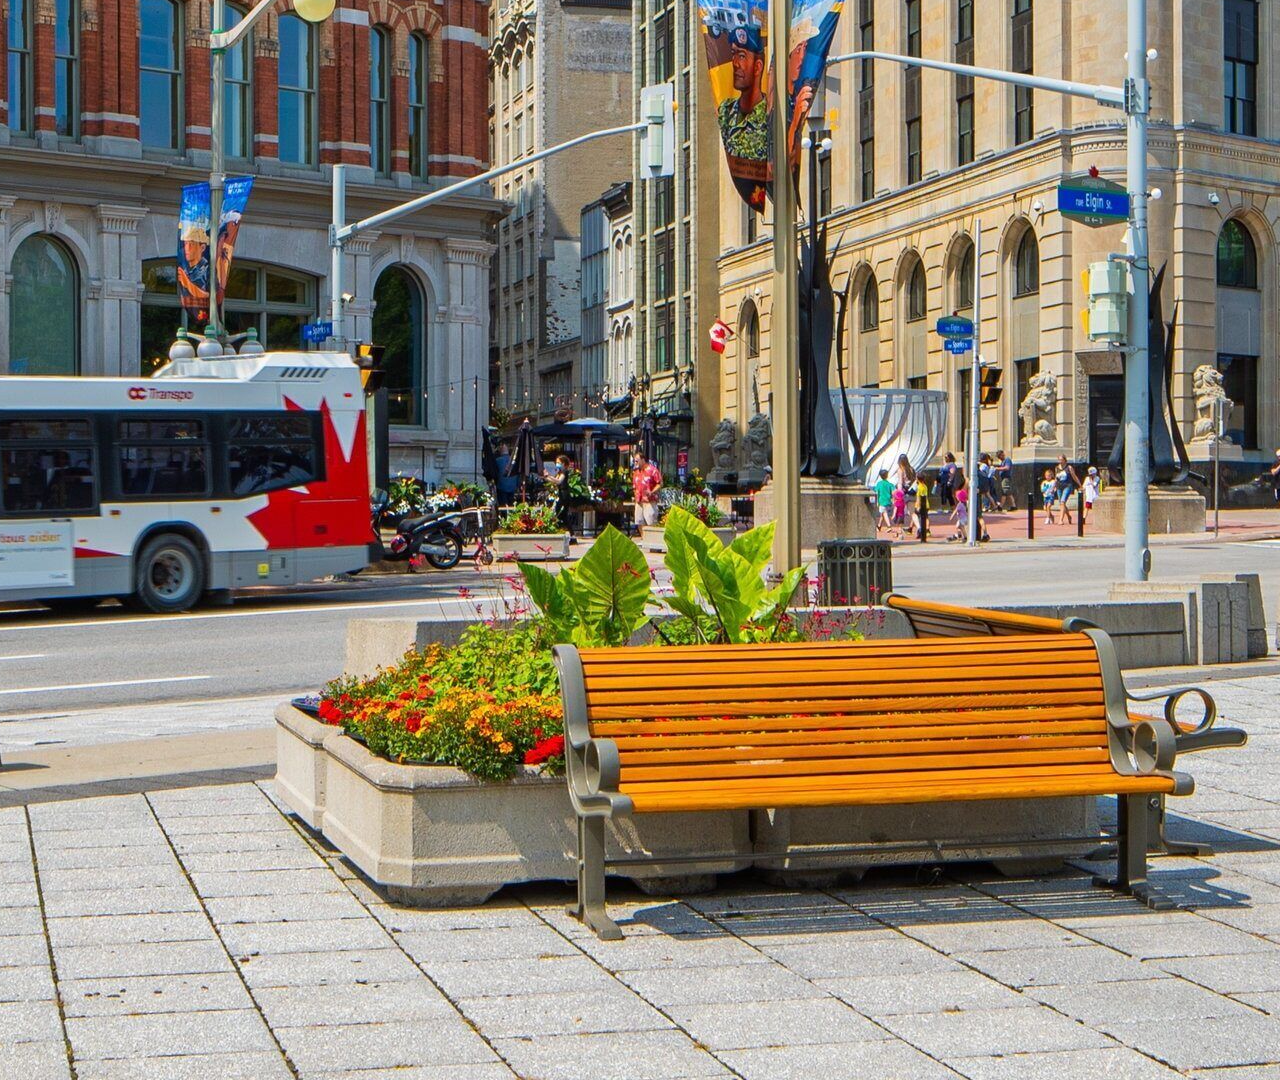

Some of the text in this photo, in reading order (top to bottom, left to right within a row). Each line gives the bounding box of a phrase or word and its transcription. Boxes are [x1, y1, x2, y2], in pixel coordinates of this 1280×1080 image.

[1075, 198, 1084, 207] rue
[1085, 192, 1104, 212] Elgin
[148, 387, 194, 402] Transpo
[0, 533, 26, 544] tous
[28, 531, 62, 543] aider
